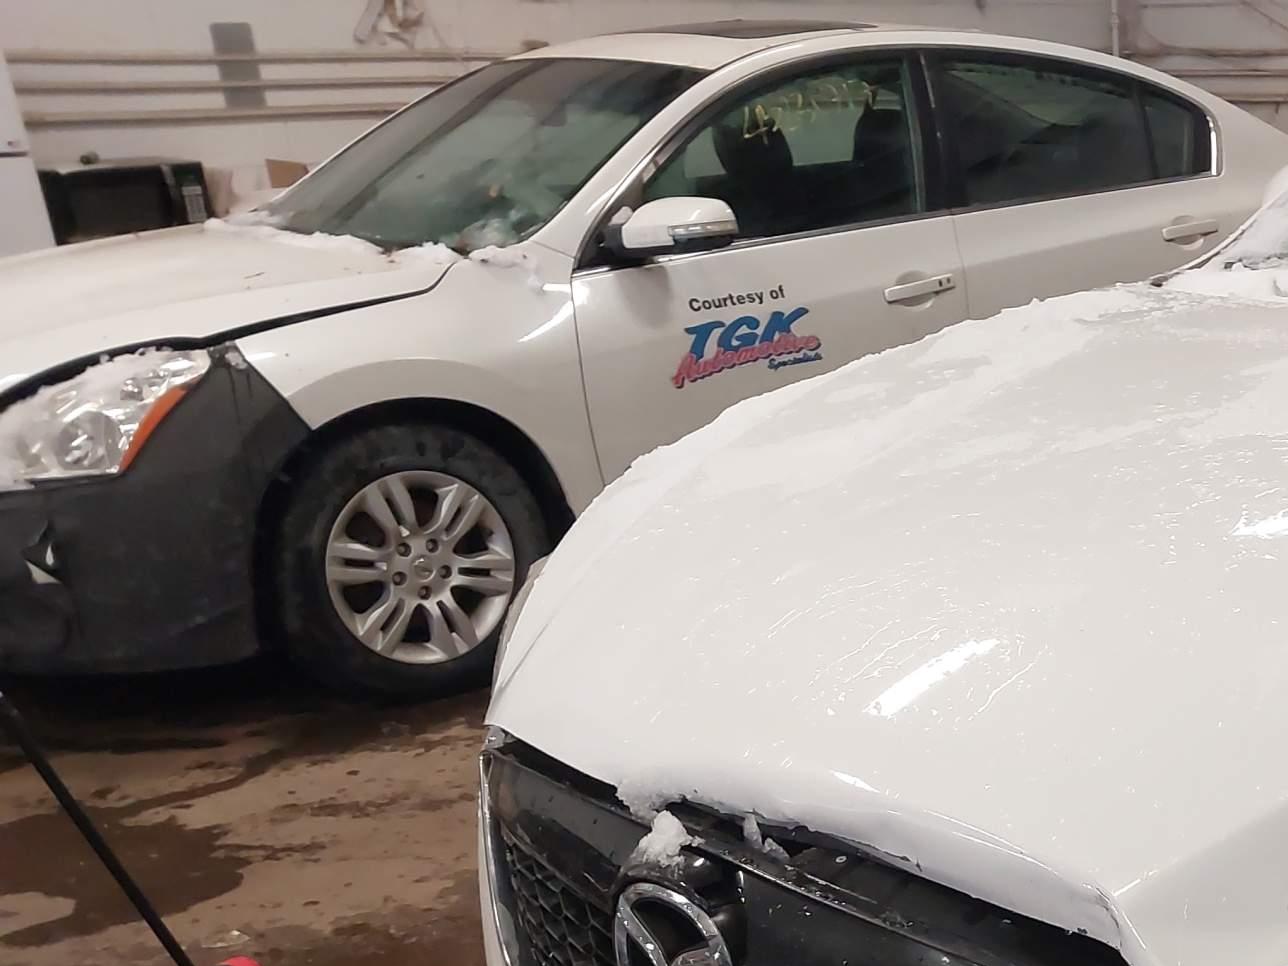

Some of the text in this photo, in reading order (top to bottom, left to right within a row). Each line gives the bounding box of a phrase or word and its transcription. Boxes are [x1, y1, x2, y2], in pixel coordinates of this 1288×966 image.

[689, 284, 786, 312] Courtesy of
[671, 332, 822, 389] Automotive
[684, 307, 810, 362] TGK
